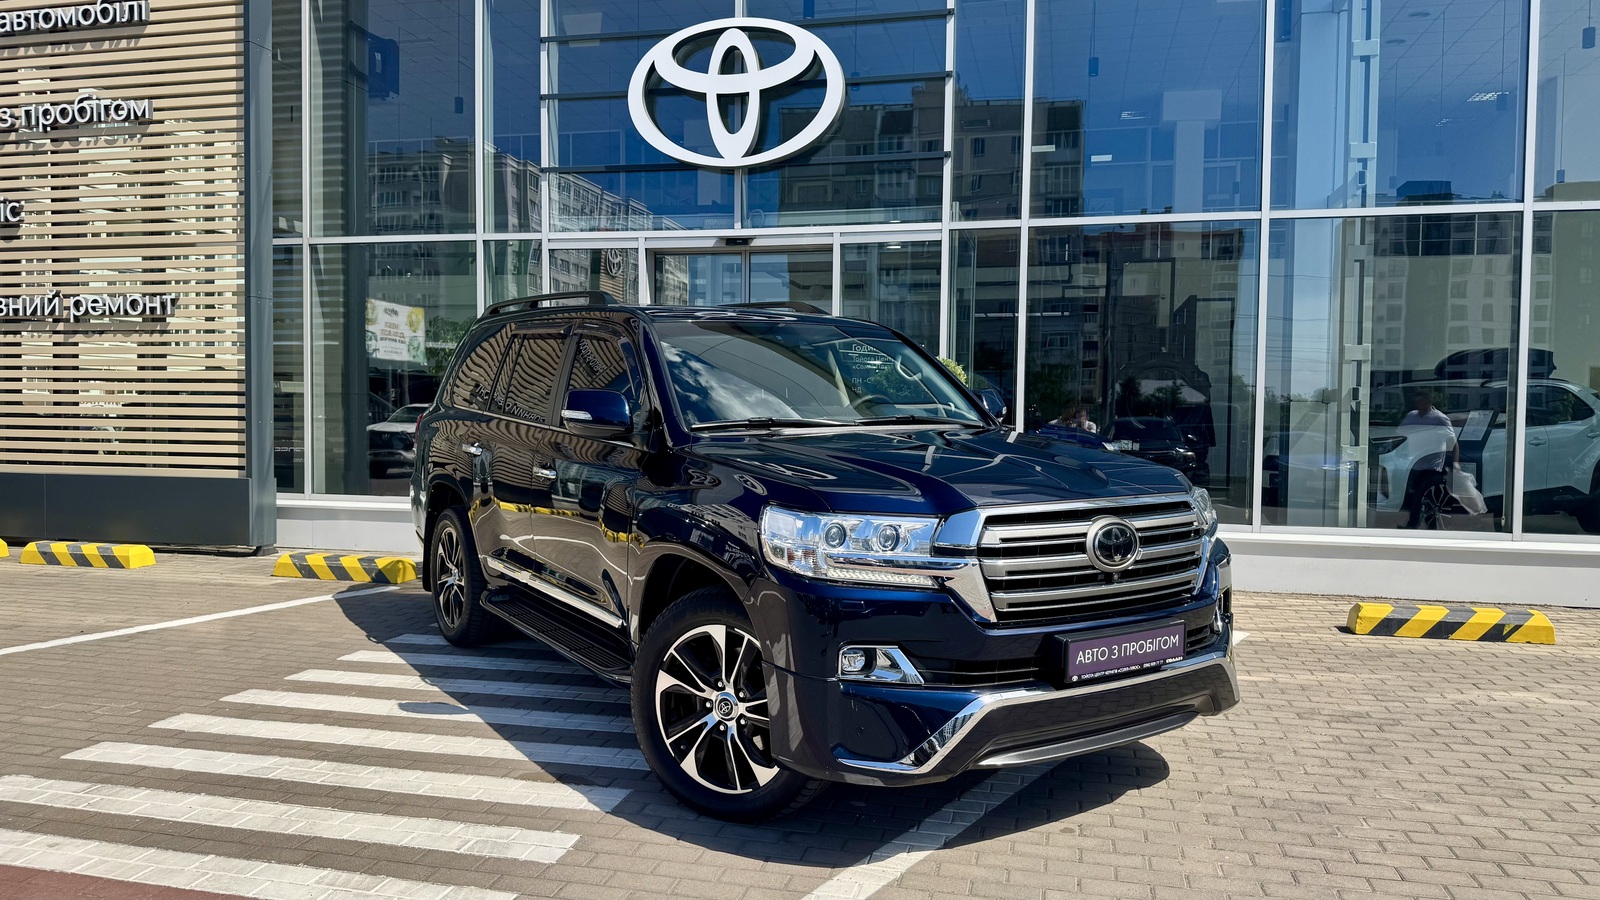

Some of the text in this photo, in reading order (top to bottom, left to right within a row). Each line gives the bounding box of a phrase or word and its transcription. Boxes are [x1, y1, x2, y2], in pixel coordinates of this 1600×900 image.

[0, 0, 146, 32] автомобілі
[0, 94, 149, 132] з пробігом
[70, 295, 175, 323] ремонт
[1076, 634, 1180, 665] АВТО З ПРОБІГОМ
